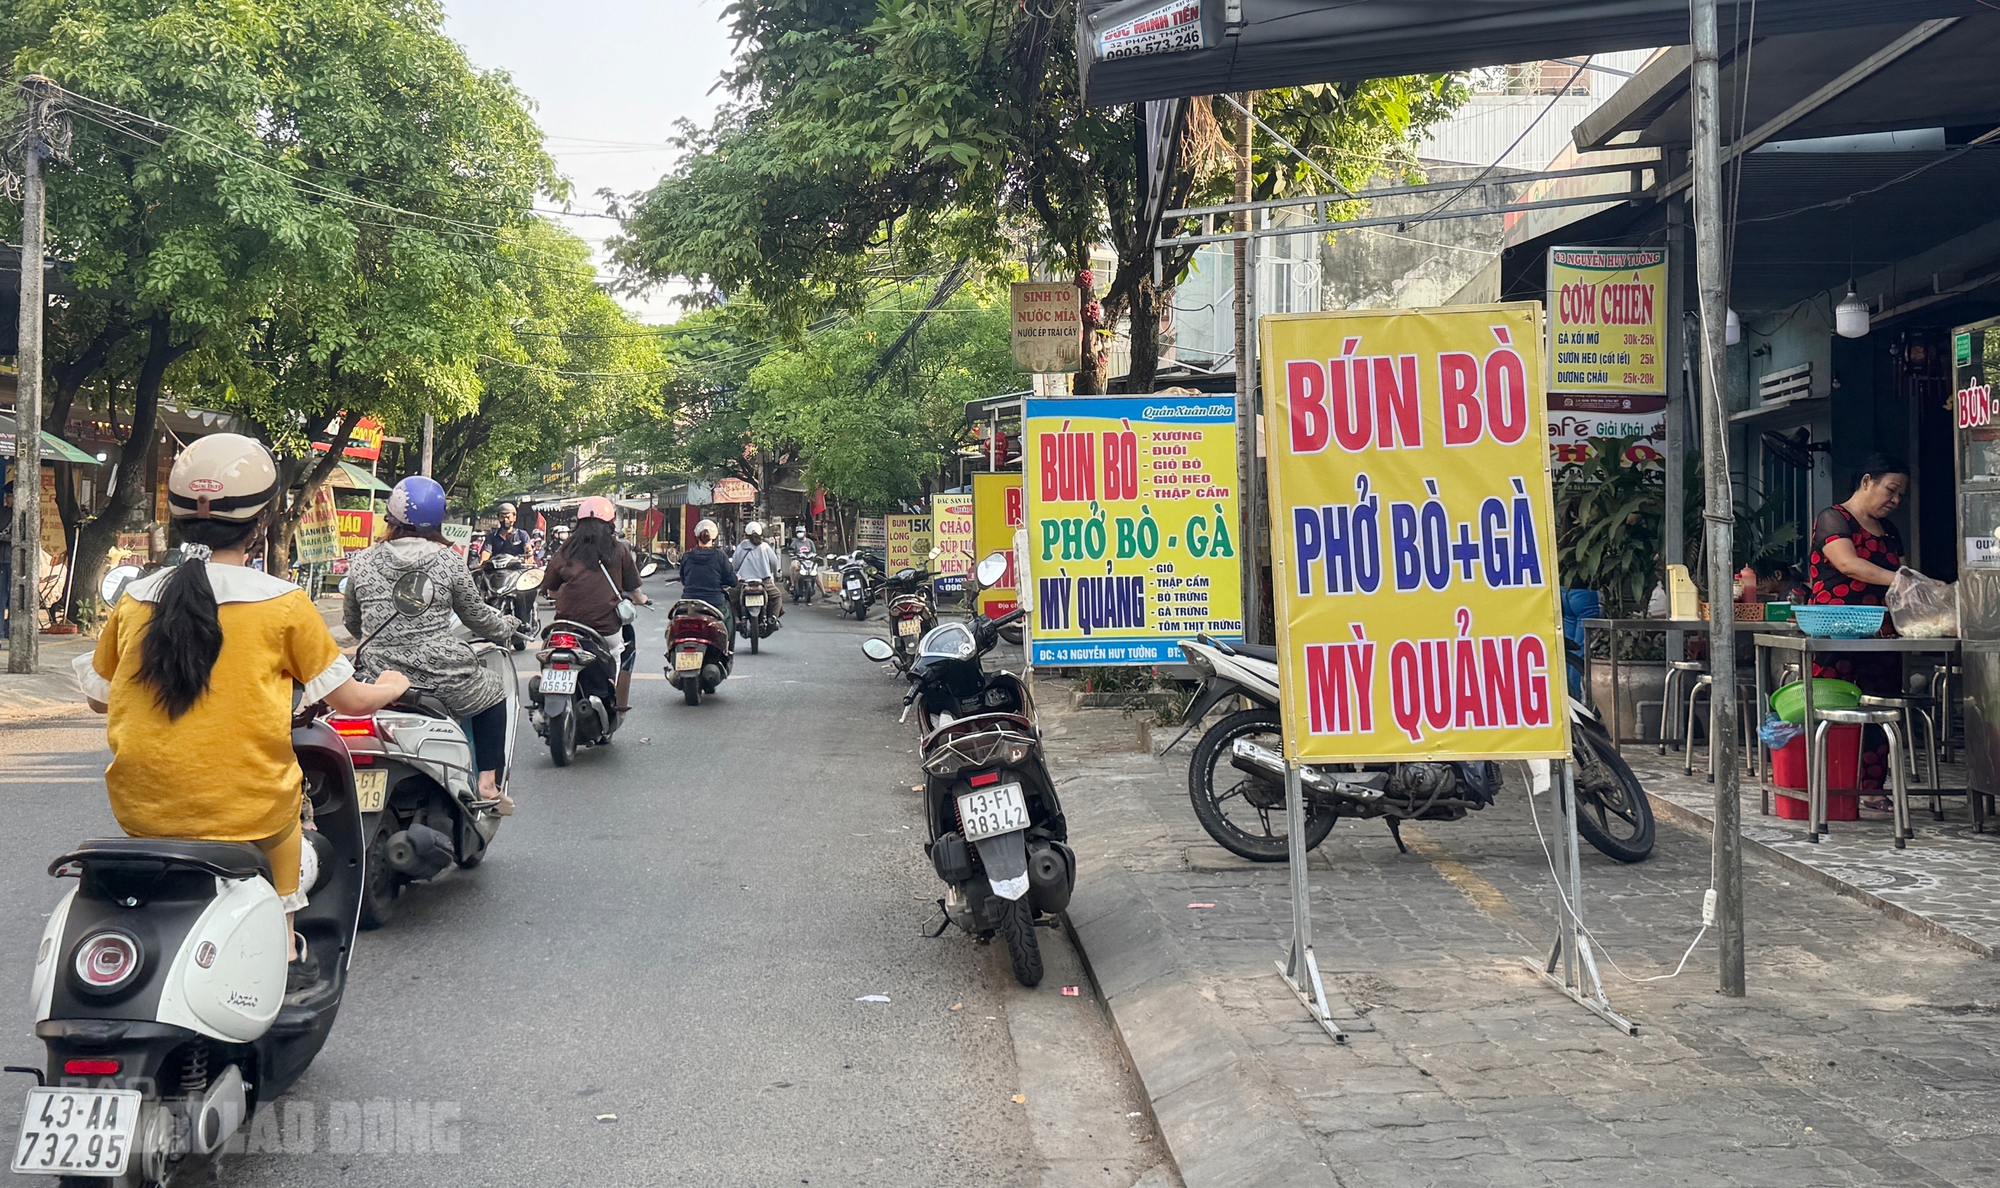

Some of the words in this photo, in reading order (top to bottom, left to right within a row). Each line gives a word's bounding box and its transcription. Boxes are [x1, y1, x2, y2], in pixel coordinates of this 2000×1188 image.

[1133, 14, 1169, 34] MINH
[1171, 4, 1199, 26] TIẾN
[1106, 30, 1200, 60] 0903.573.246
[1125, 35, 1156, 46] PHAN
[1554, 252, 1566, 262] 43
[1606, 254, 1627, 267] HUY
[1023, 290, 1052, 302] SINH
[1055, 286, 1071, 302] TỐ
[1560, 276, 1597, 324] CƠM
[1600, 271, 1654, 325] CHIÊN
[1017, 308, 1052, 323] NƯỚC
[1054, 308, 1077, 322] MÍA
[1017, 326, 1038, 337] NƯỚC
[1581, 352, 1597, 365] HEO
[1640, 353, 1655, 365] 25k
[1557, 371, 1585, 383] DƯƠNG
[1623, 372, 1655, 384] 25k-20k
[1288, 336, 1422, 453] BÚN
[1438, 326, 1528, 446] BÒ
[1958, 377, 1990, 428] BÚN
[1143, 405, 1174, 419] Quán
[1175, 405, 1208, 417] Xuân
[1548, 416, 1592, 437] afé
[1596, 420, 1618, 436] Giải
[1620, 421, 1645, 436] Khát
[1152, 431, 1203, 441] XƯƠNG
[1152, 445, 1187, 456] ĐUÔI
[1040, 420, 1096, 501] BÚN
[1102, 419, 1137, 500] BÒ
[1182, 458, 1202, 469] BÒ
[1182, 475, 1211, 484] HEO
[1153, 487, 1191, 501] THẬP
[338, 512, 362, 533] HÁO
[907, 519, 932, 532] 15K
[1040, 501, 1107, 560] PHỞ
[1115, 504, 1159, 559] BÒ
[1186, 503, 1235, 558] GÀ
[1293, 473, 1379, 595] PHỞ
[1157, 577, 1183, 590] THẬP
[1039, 568, 1072, 630] MỲ
[1077, 560, 1145, 635] QUẢNG
[1157, 590, 1171, 602] BÒ
[1175, 590, 1208, 602] TRỨNG
[1157, 605, 1172, 617] GÀ
[1175, 605, 1209, 617] TRỨNG
[1158, 619, 1180, 631] TÔM
[1183, 621, 1205, 633] THỊT
[1207, 619, 1242, 631] TRỨNG
[1040, 650, 1055, 661] ĐC:
[1057, 650, 1069, 660] 43
[1108, 648, 1127, 660] HUY
[1305, 623, 1376, 735] MỲ
[1390, 606, 1552, 743] QUẢNG
[969, 788, 1013, 816] 43-F1
[967, 806, 1026, 837] 383.42
[23, 1132, 125, 1169] 732.95
